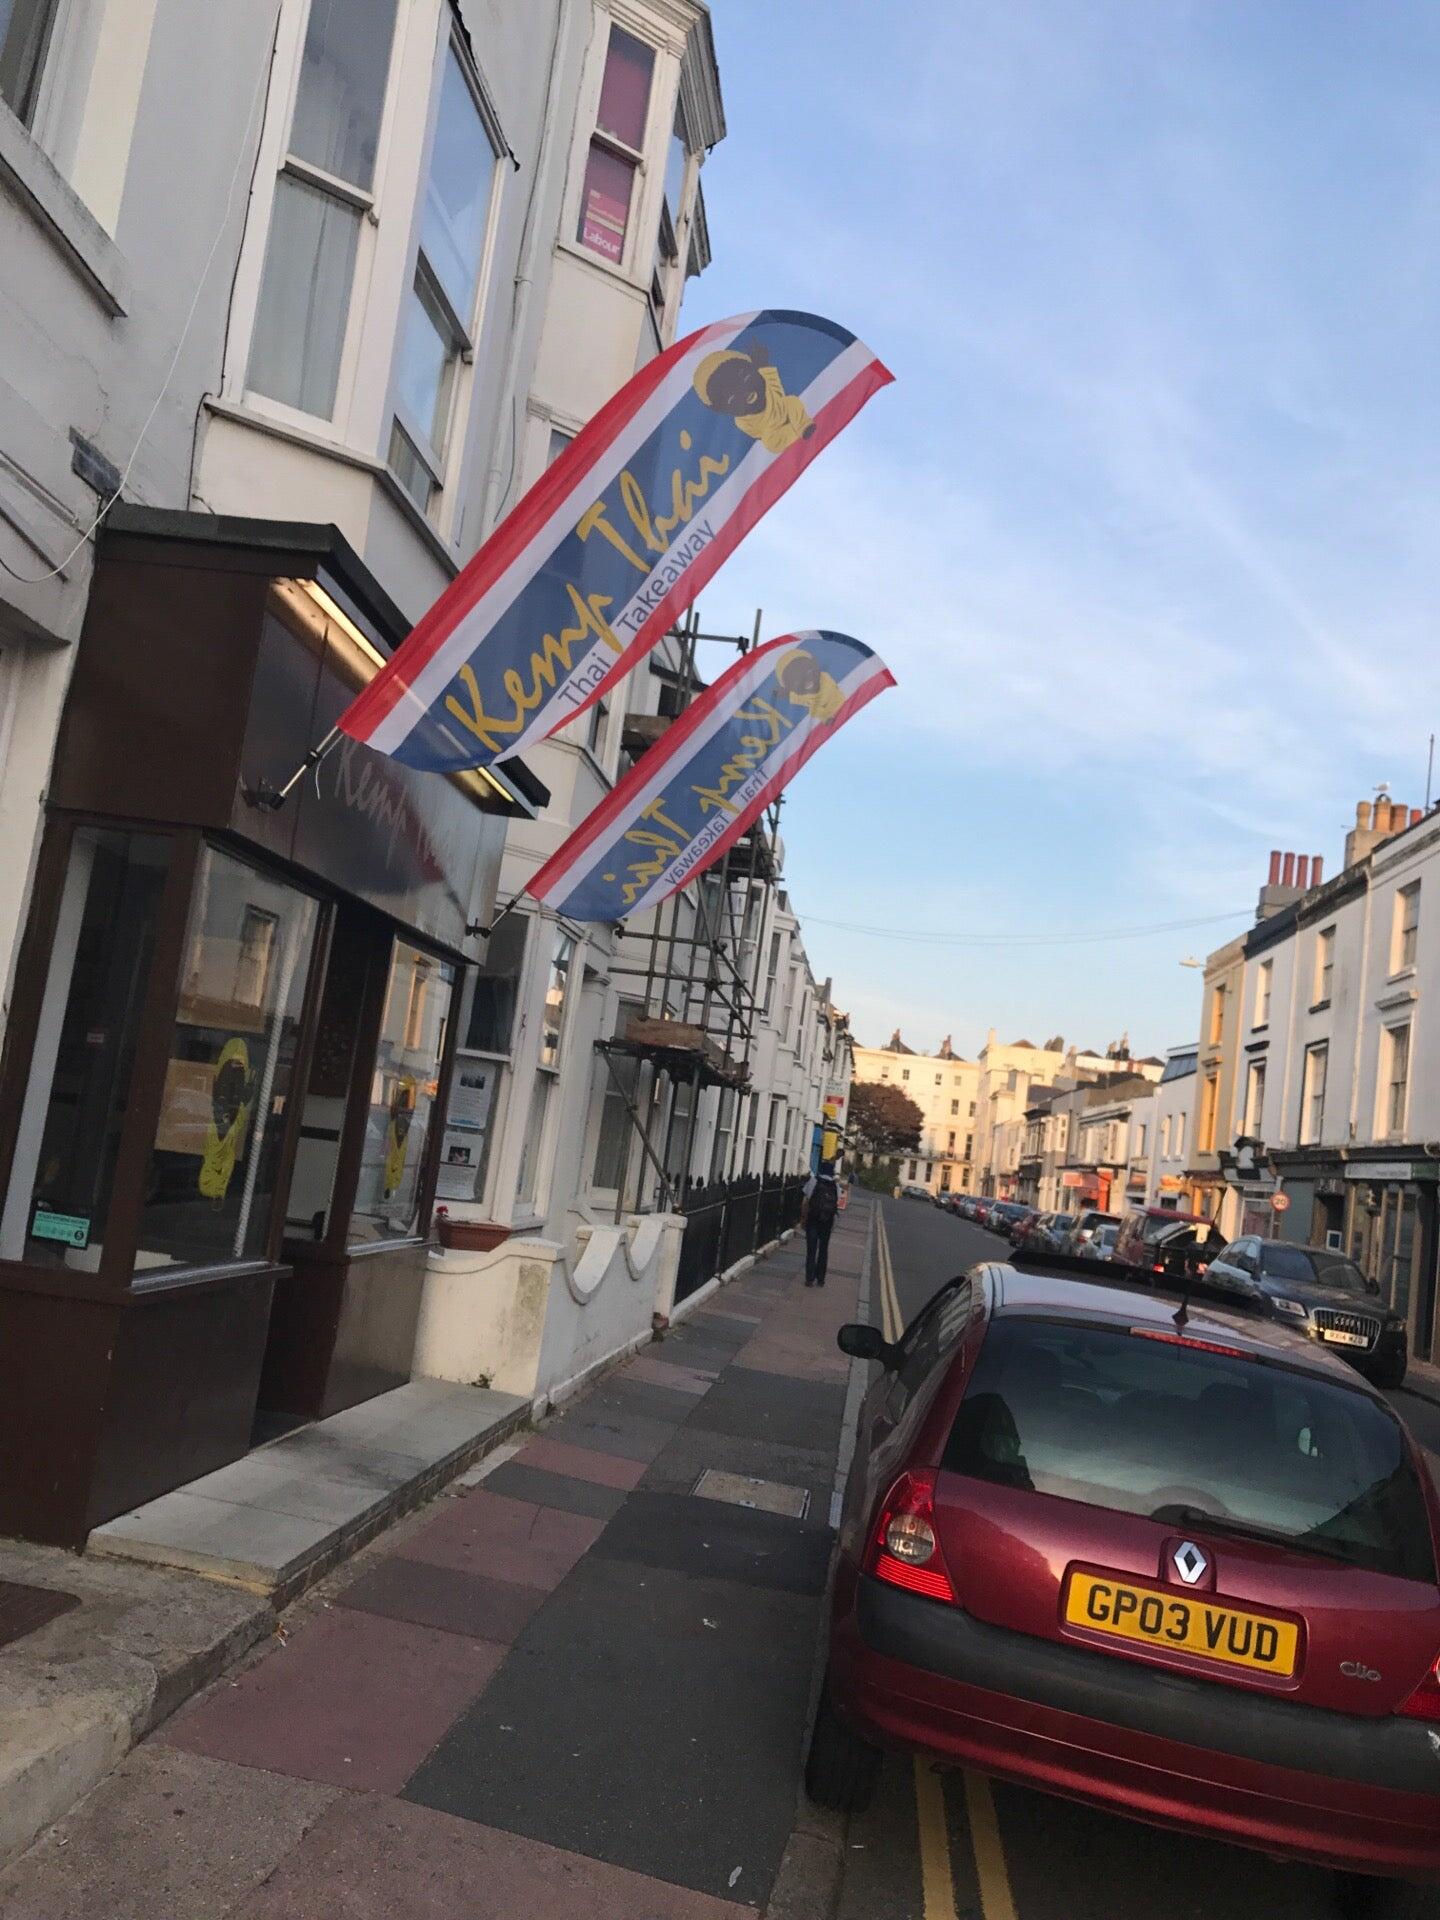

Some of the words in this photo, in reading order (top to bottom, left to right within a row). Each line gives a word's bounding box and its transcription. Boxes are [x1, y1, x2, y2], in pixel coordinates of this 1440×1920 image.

[584, 227, 621, 254] Labour
[445, 583, 625, 753] Kemp
[576, 430, 729, 573] Thai
[559, 652, 612, 707] Thai
[616, 520, 718, 638] Takeaway
[1087, 1584, 1190, 1640] GP03
[1205, 1610, 1279, 1663] VUD
[1340, 1661, 1382, 1681] Clio
